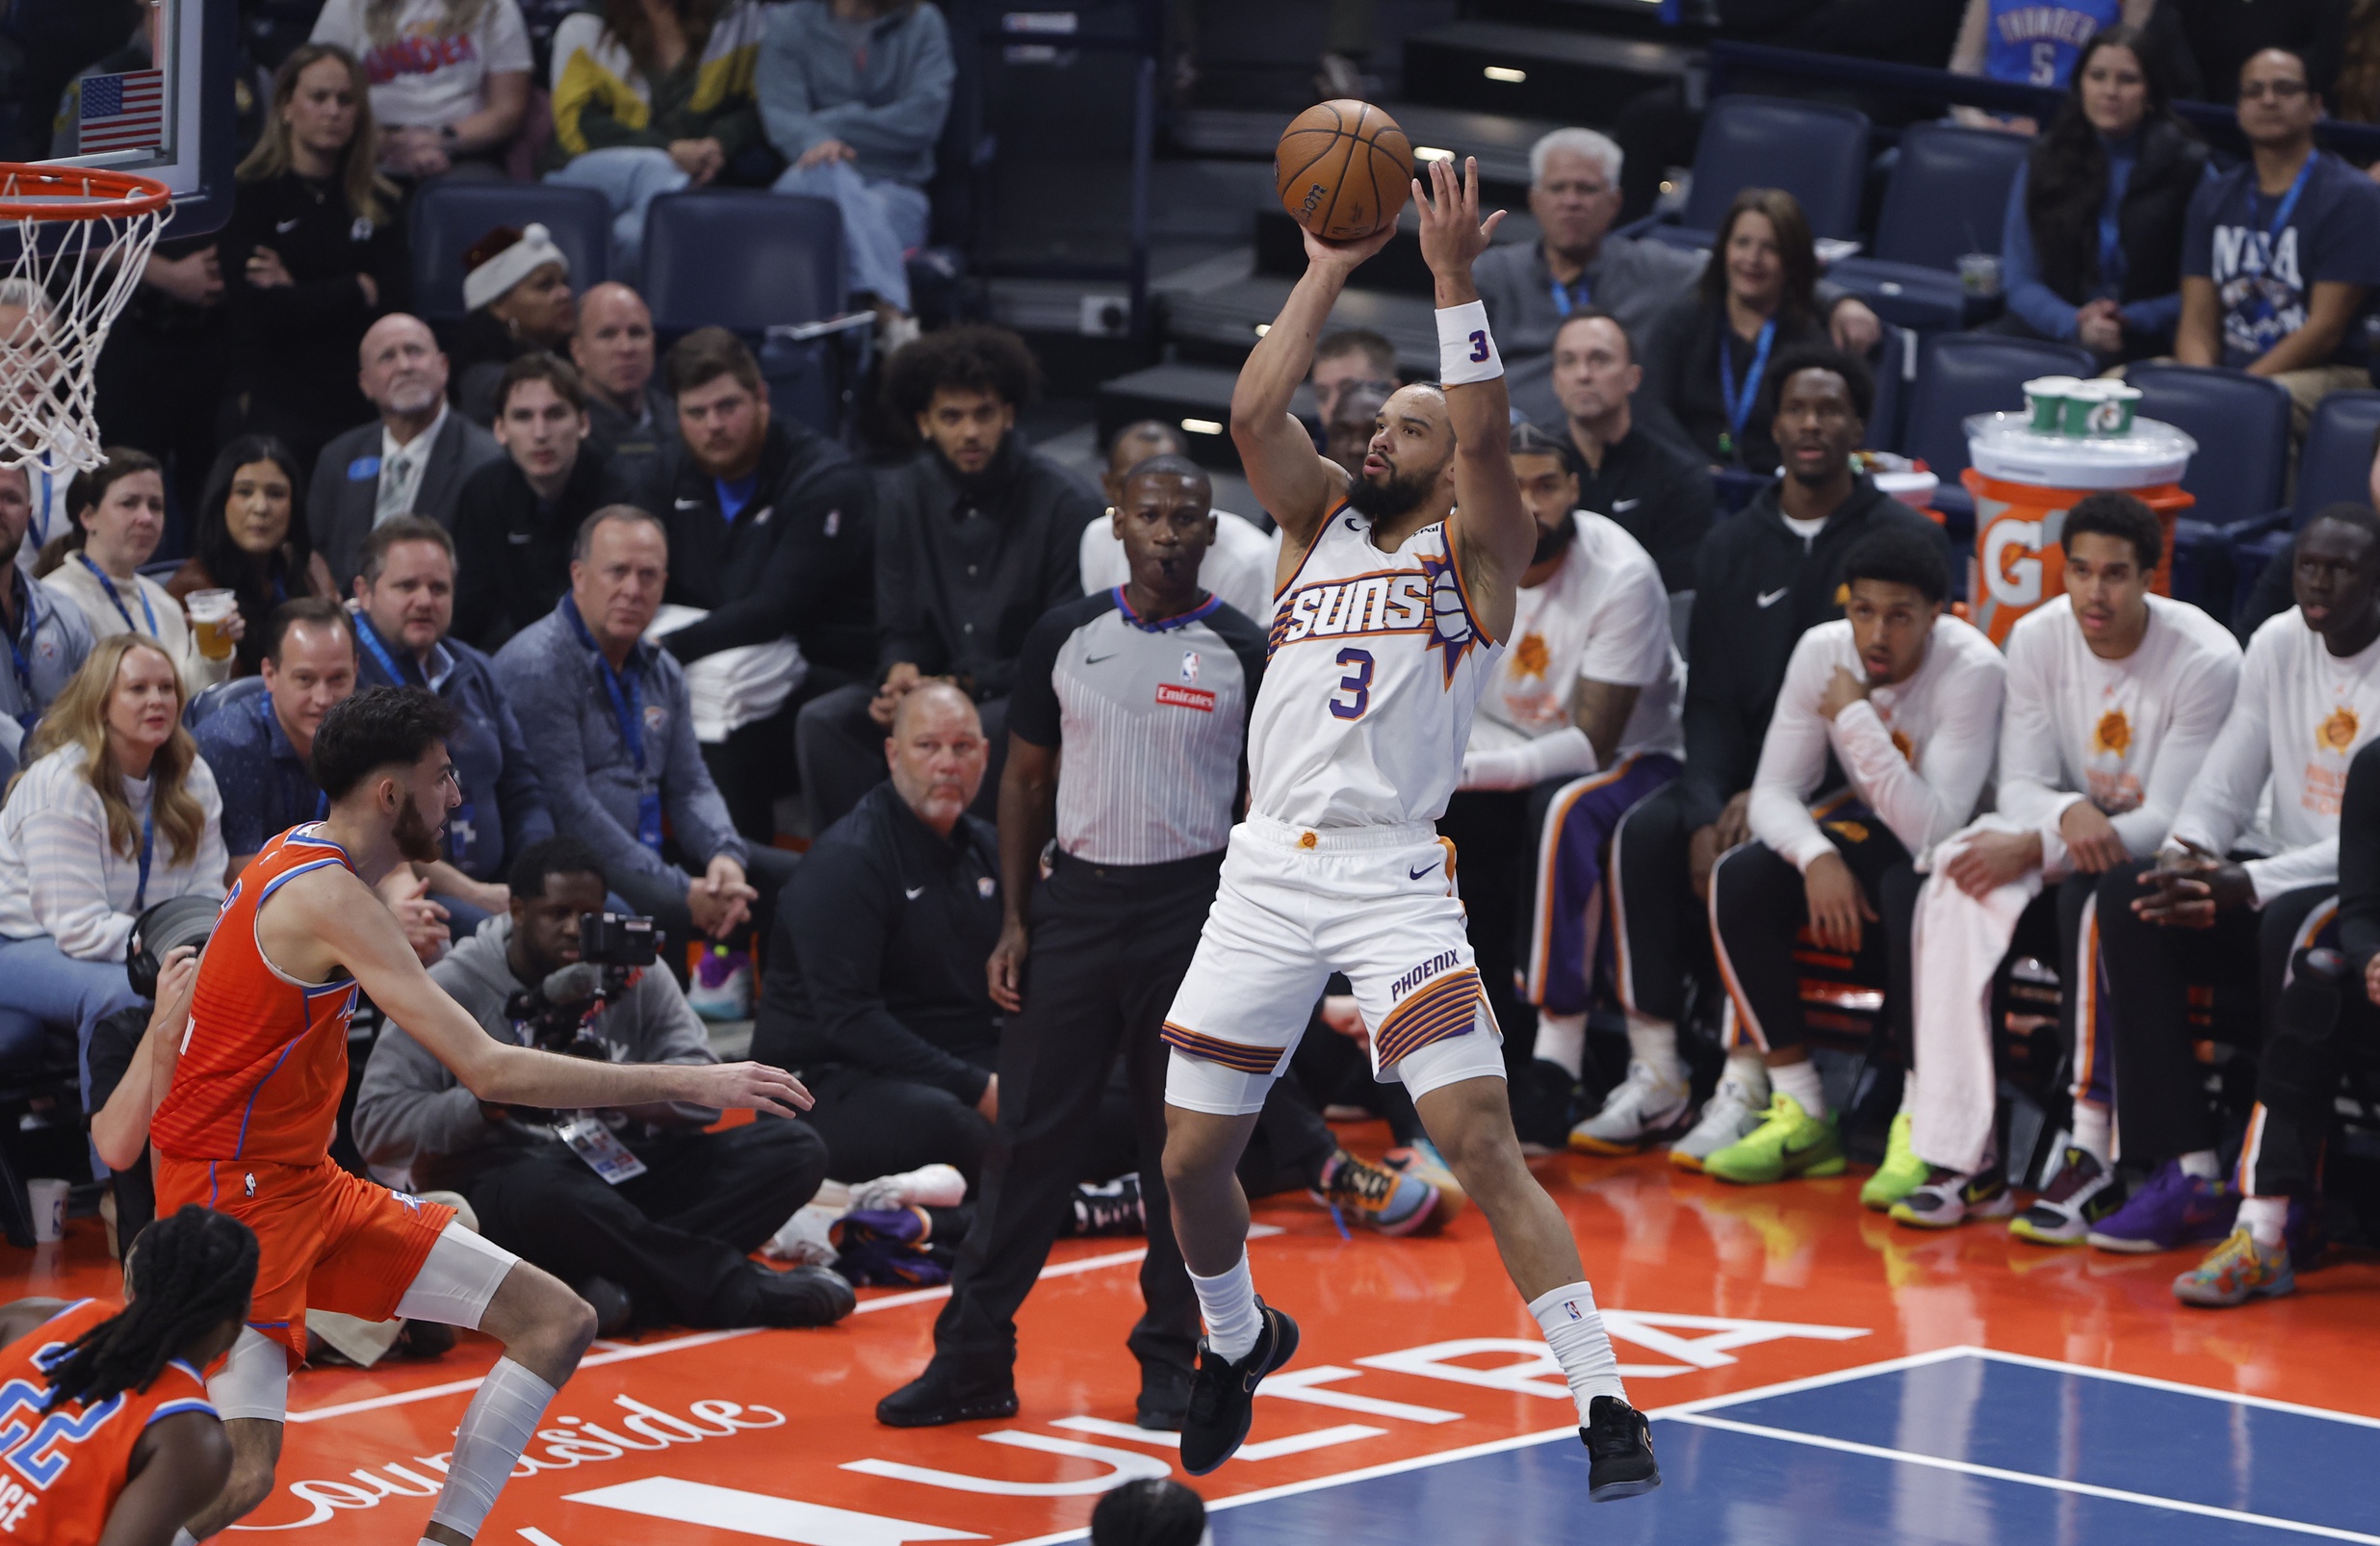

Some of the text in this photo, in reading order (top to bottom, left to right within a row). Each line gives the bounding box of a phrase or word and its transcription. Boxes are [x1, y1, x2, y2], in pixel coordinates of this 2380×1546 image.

[1997, 6, 2097, 49] THUNDER
[2029, 41, 2056, 88] 5
[1468, 329, 1489, 363] 3
[1983, 518, 2043, 607] G
[1284, 575, 1428, 643] SUNS
[1157, 685, 1214, 708] Emirates
[1329, 647, 1376, 722] 3
[1390, 948, 1461, 1003] PHOENIX
[0, 1341, 127, 1491] 22
[223, 1393, 787, 1532] ourside
